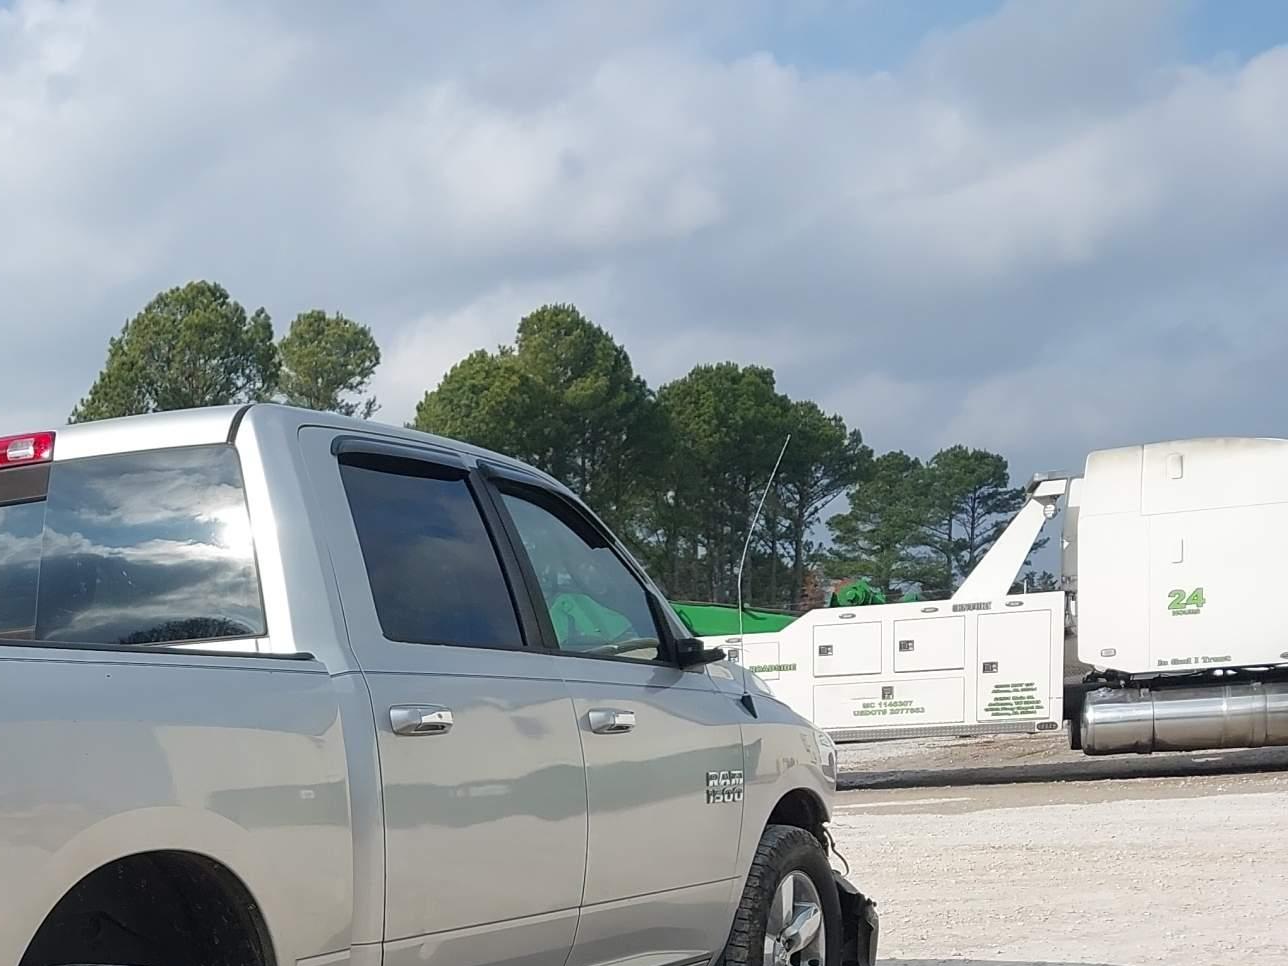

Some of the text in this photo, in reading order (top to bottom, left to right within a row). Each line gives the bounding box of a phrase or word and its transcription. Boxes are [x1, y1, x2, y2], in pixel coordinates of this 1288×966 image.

[1168, 588, 1205, 609] 24
[706, 771, 743, 786] RAM
[706, 788, 743, 804] 1500
